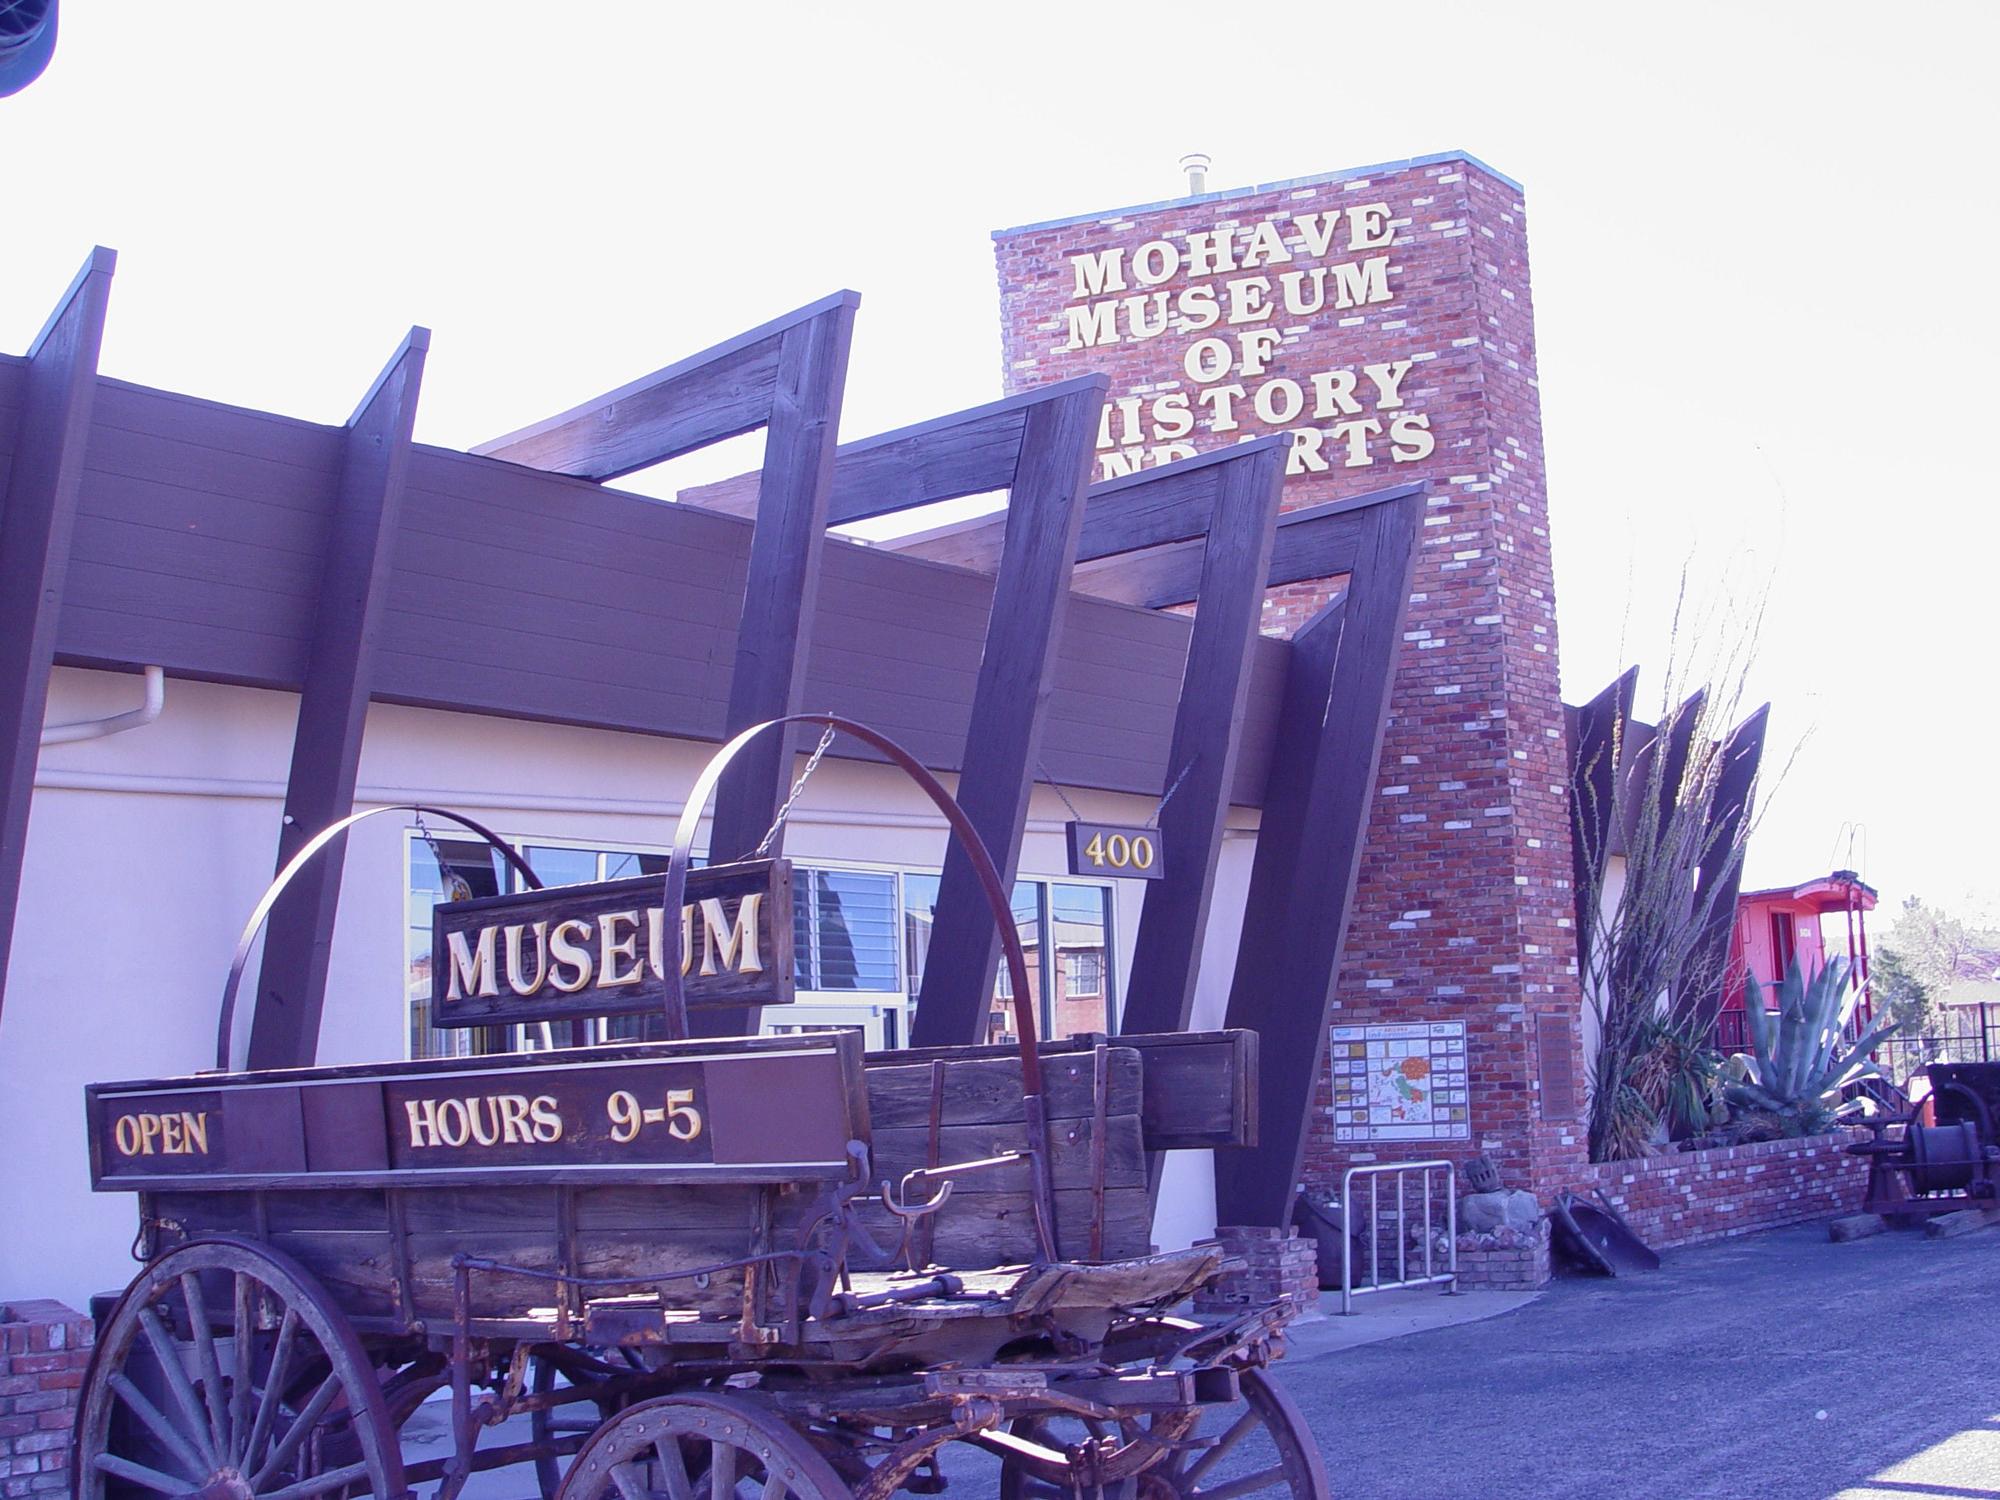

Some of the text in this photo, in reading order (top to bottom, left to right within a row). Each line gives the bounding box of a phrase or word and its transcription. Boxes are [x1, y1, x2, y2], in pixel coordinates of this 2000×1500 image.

[1071, 201, 1397, 299] MOHAVE
[1065, 255, 1394, 350] MUSEUM
[1184, 327, 1283, 384] OF
[1238, 413, 1436, 476] RTS
[1085, 831, 1154, 870] 400
[446, 892, 764, 1001] MUSEUM
[114, 1111, 208, 1157] OPEN
[404, 1088, 703, 1149] HOURS 9-5
